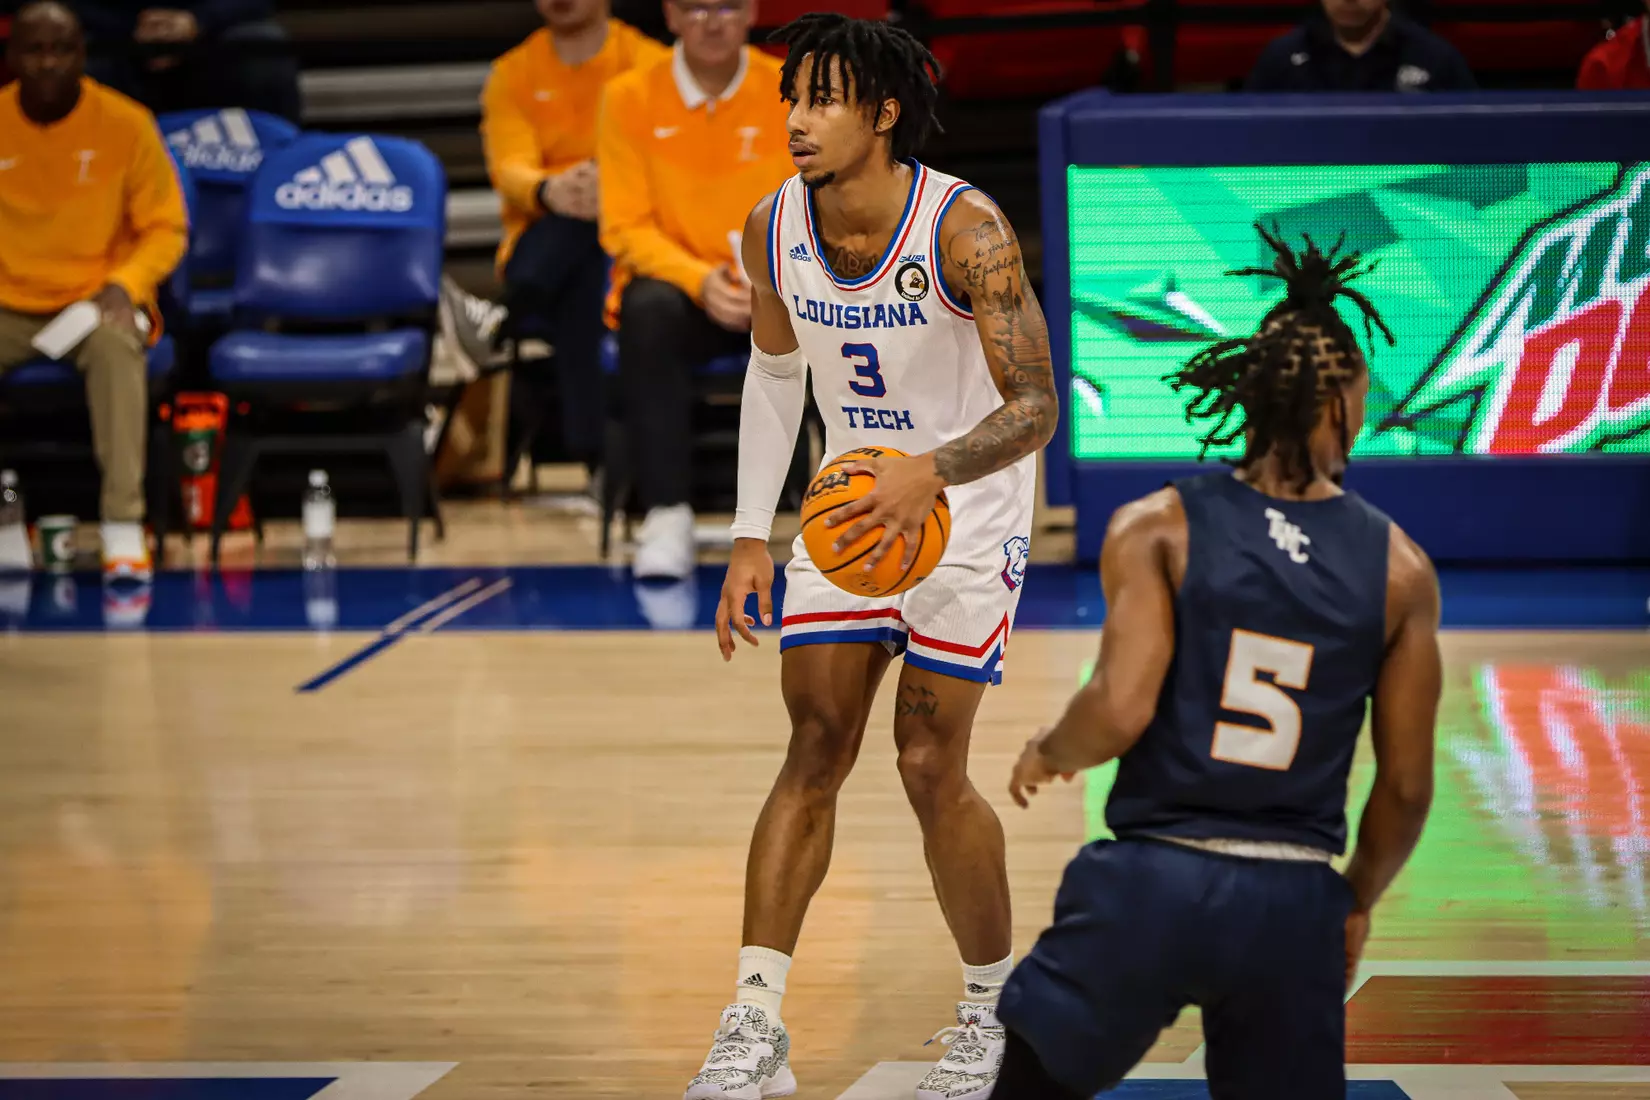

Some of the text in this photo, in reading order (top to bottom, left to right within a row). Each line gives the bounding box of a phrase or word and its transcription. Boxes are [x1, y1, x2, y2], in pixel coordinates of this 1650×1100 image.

[275, 181, 414, 213] adidas
[793, 294, 928, 329] LOUISIANA
[841, 342, 887, 398] 3
[841, 406, 915, 430] TECH
[1210, 628, 1315, 771] 5
